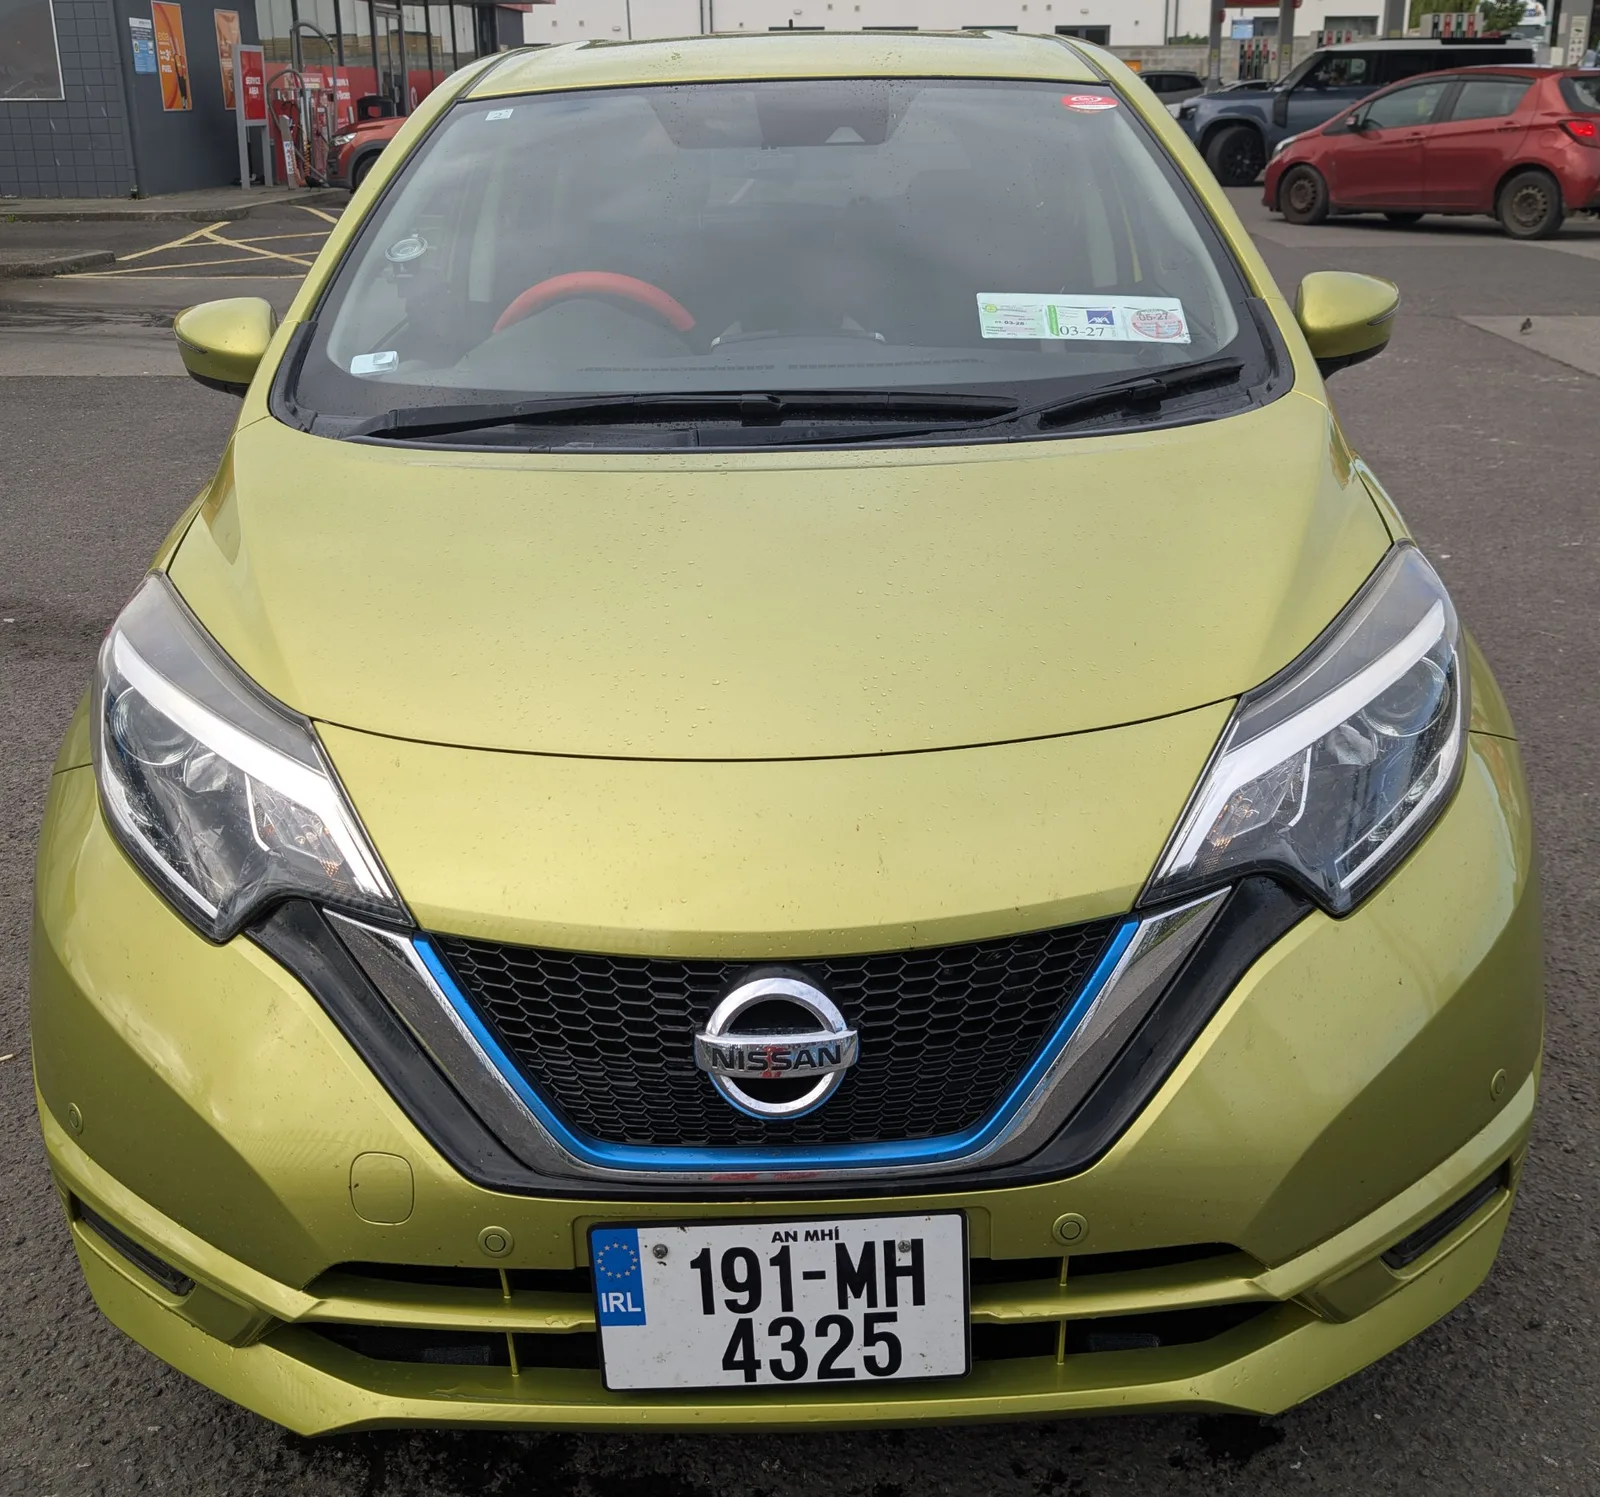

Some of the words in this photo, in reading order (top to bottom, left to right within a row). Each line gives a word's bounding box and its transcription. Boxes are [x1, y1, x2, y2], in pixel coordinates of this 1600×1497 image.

[1060, 325, 1105, 337] 03-27
[712, 1044, 841, 1072] NISSAN
[771, 1230, 798, 1243] AN
[804, 1226, 840, 1242] MHÍ
[690, 1238, 926, 1315] 191-MH
[601, 1292, 642, 1313] IRL
[722, 1311, 902, 1383] 4325
